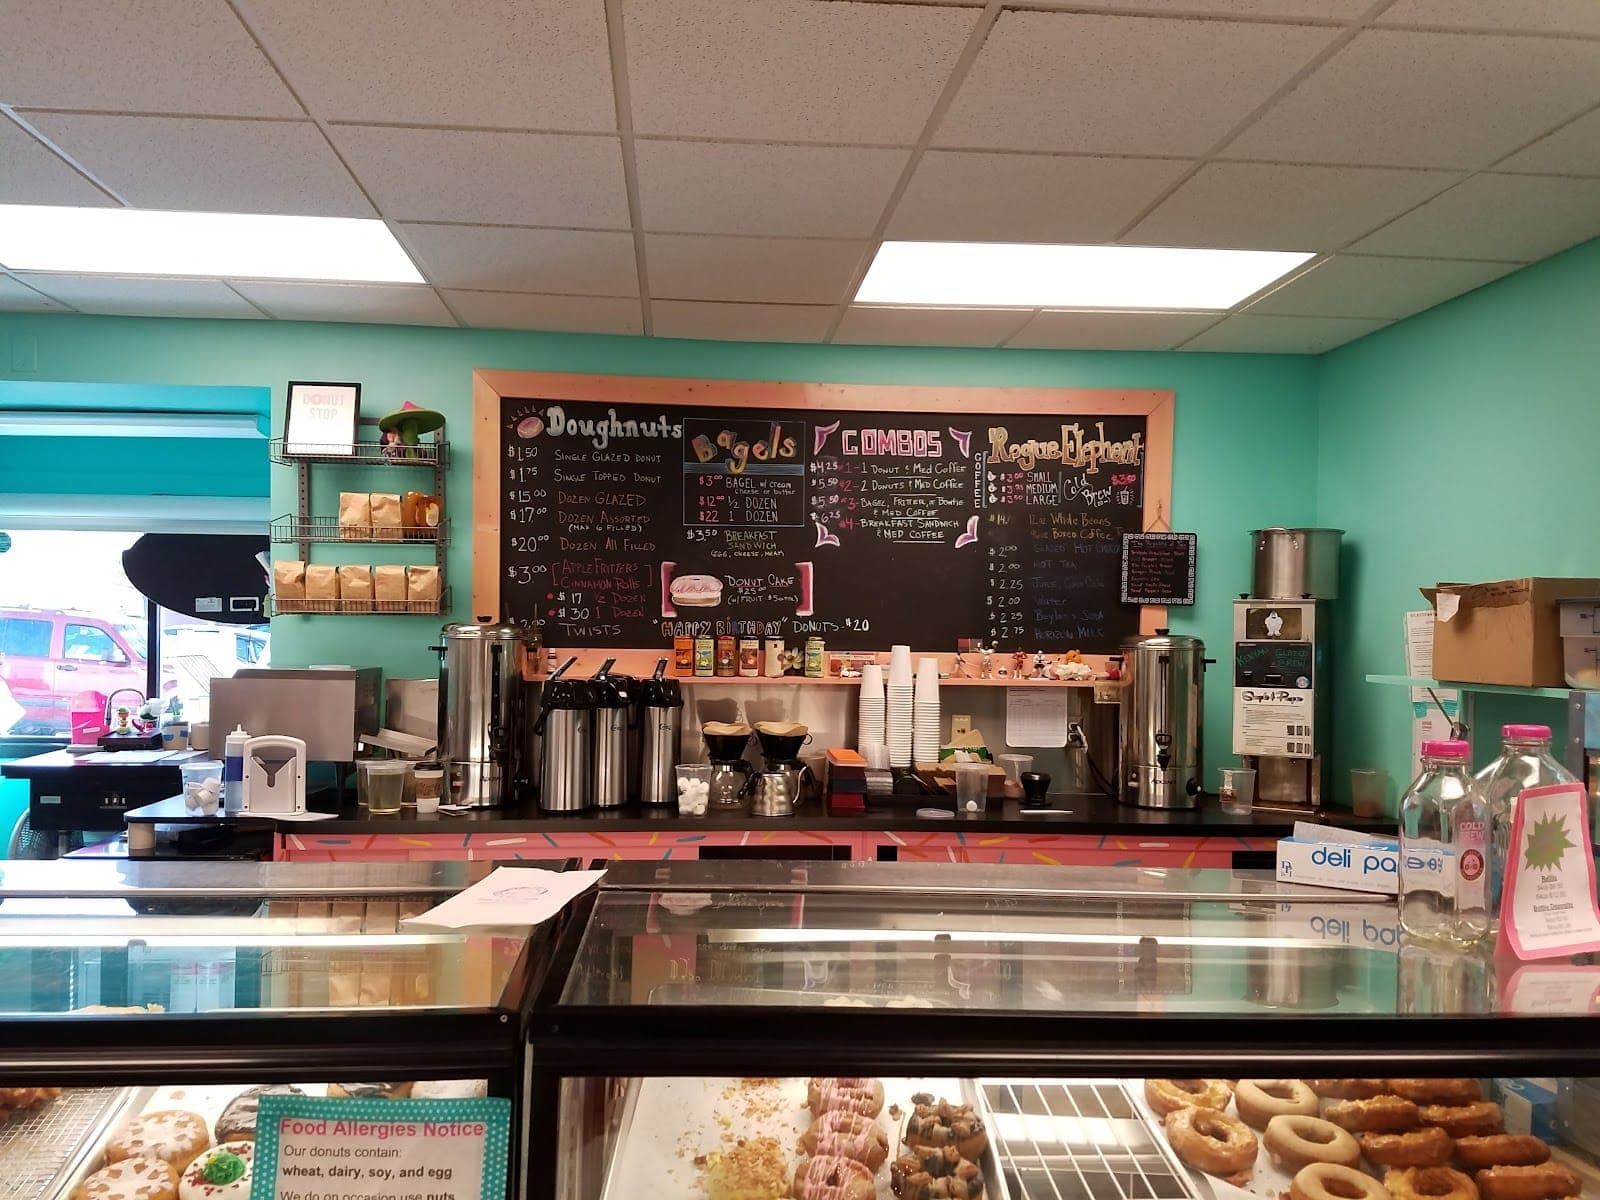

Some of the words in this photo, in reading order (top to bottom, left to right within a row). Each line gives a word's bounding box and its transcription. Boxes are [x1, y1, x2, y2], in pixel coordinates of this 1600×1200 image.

[546, 406, 683, 450] Doughnuts
[691, 422, 797, 474] Bagels
[987, 426, 1063, 471] Rogue
[1061, 422, 1144, 475] Elephant
[870, 464, 900, 474] DONUT
[725, 477, 757, 489] BAGEL
[769, 481, 792, 489] cream
[1026, 472, 1053, 483] SMALL
[871, 480, 905, 491] DONUTS
[1025, 483, 1059, 495] MEDIUM
[1063, 473, 1089, 501] Cold
[595, 492, 647, 506] GLAZED
[745, 497, 778, 510] DOZEN
[1025, 496, 1059, 505] LARGE
[699, 511, 719, 523] $22
[728, 511, 735, 522] 1
[745, 510, 778, 523] DOZEN
[860, 518, 913, 529] BREAKFAST
[917, 519, 960, 529] SANDWICH
[724, 529, 779, 542] BREAKFAST
[559, 537, 597, 552] DOZEN
[623, 537, 657, 552] FILLED
[727, 542, 777, 550] SANDWICH
[724, 574, 764, 587] DONUT
[767, 573, 795, 587] CAKE
[558, 622, 622, 637] TWISTS
[1311, 847, 1351, 869] deli
[280, 1119, 326, 1136] Food
[333, 1121, 416, 1140] Allergies
[423, 1121, 484, 1137] Notice
[284, 1145, 306, 1157] Our
[310, 1146, 350, 1158] donuts
[354, 1147, 402, 1159] contain:
[282, 1165, 325, 1178] wheat,
[328, 1166, 364, 1181] dairy,
[368, 1168, 395, 1181] soy,
[399, 1166, 425, 1178] and
[428, 1167, 453, 1181] egg
[280, 1191, 302, 1200] We
[307, 1191, 322, 1200] do
[427, 1192, 455, 1200] nuts
